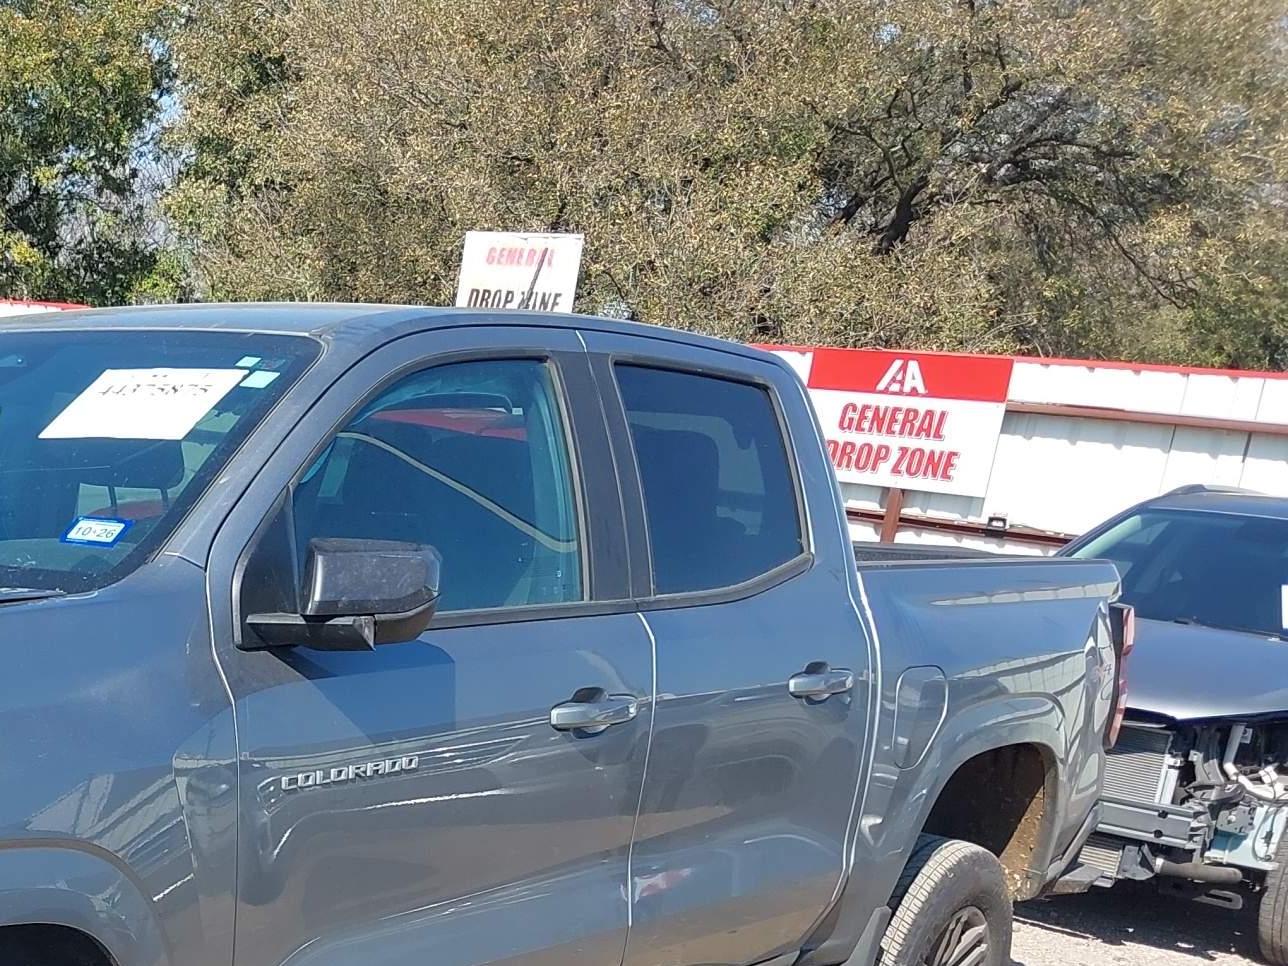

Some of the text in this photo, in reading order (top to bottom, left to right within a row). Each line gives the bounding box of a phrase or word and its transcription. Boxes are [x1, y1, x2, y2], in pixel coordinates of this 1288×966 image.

[838, 403, 948, 441] GENERAL
[825, 440, 960, 481] DROP ZONE
[281, 756, 419, 791] COLORADO
